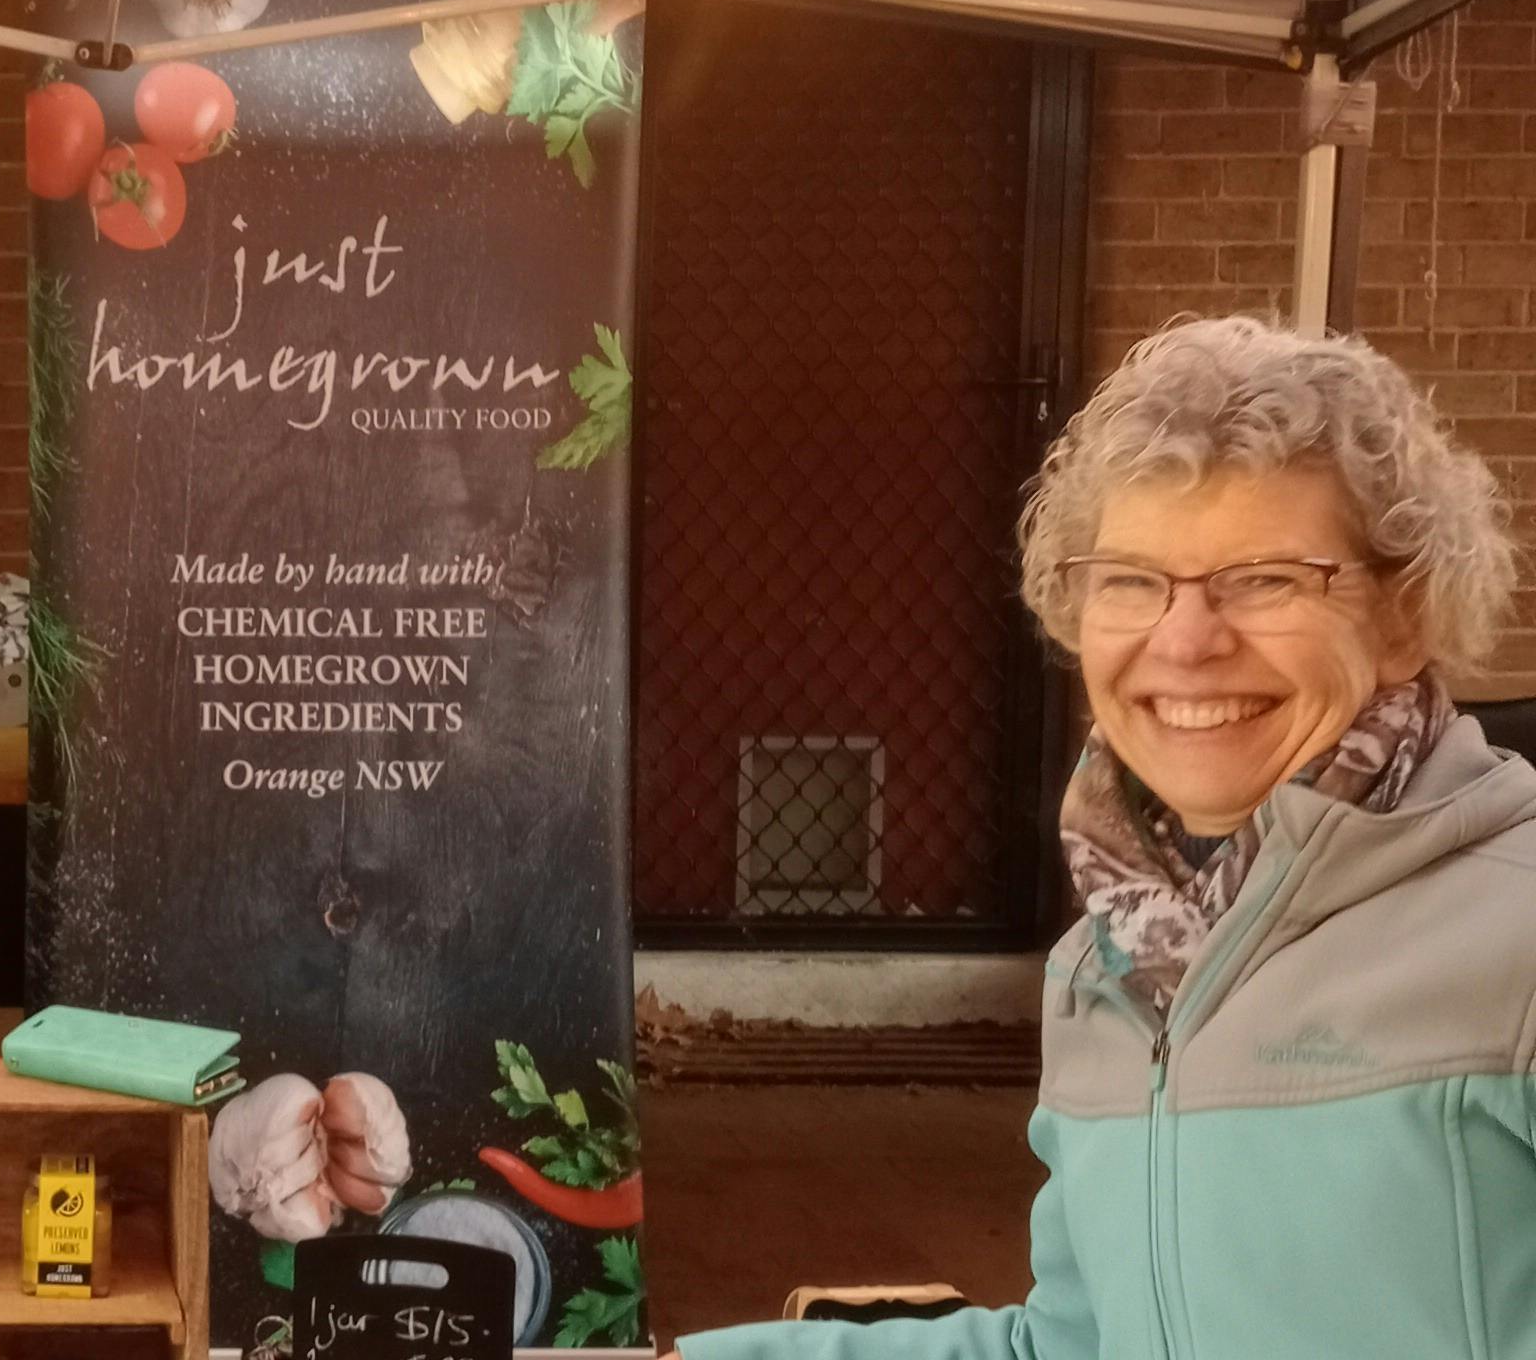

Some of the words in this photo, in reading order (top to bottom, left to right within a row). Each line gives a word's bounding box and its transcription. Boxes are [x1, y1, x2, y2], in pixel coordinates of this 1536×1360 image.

[206, 213, 403, 342] just
[87, 298, 560, 431] homegrown
[351, 406, 467, 431] QUALITY
[475, 407, 552, 430] FOOD
[170, 553, 264, 585] Made
[275, 553, 314, 592] by
[325, 553, 410, 585] hand
[418, 552, 493, 585] with
[177, 606, 383, 638] CHEMICAL
[394, 607, 488, 638] FREE
[193, 653, 471, 686] HOMEGROWN
[200, 701, 464, 733] INGREDIENTS
[223, 759, 345, 798] Orange
[354, 760, 446, 791] NSW
[43, 1225, 89, 1241] PRESERVED
[50, 1241, 81, 1256] LEMONS
[46, 1273, 84, 1284] HOMEGROWN
[56, 1264, 74, 1274] JUST
[310, 1296, 317, 1327] 1
[314, 1303, 379, 1350] jar
